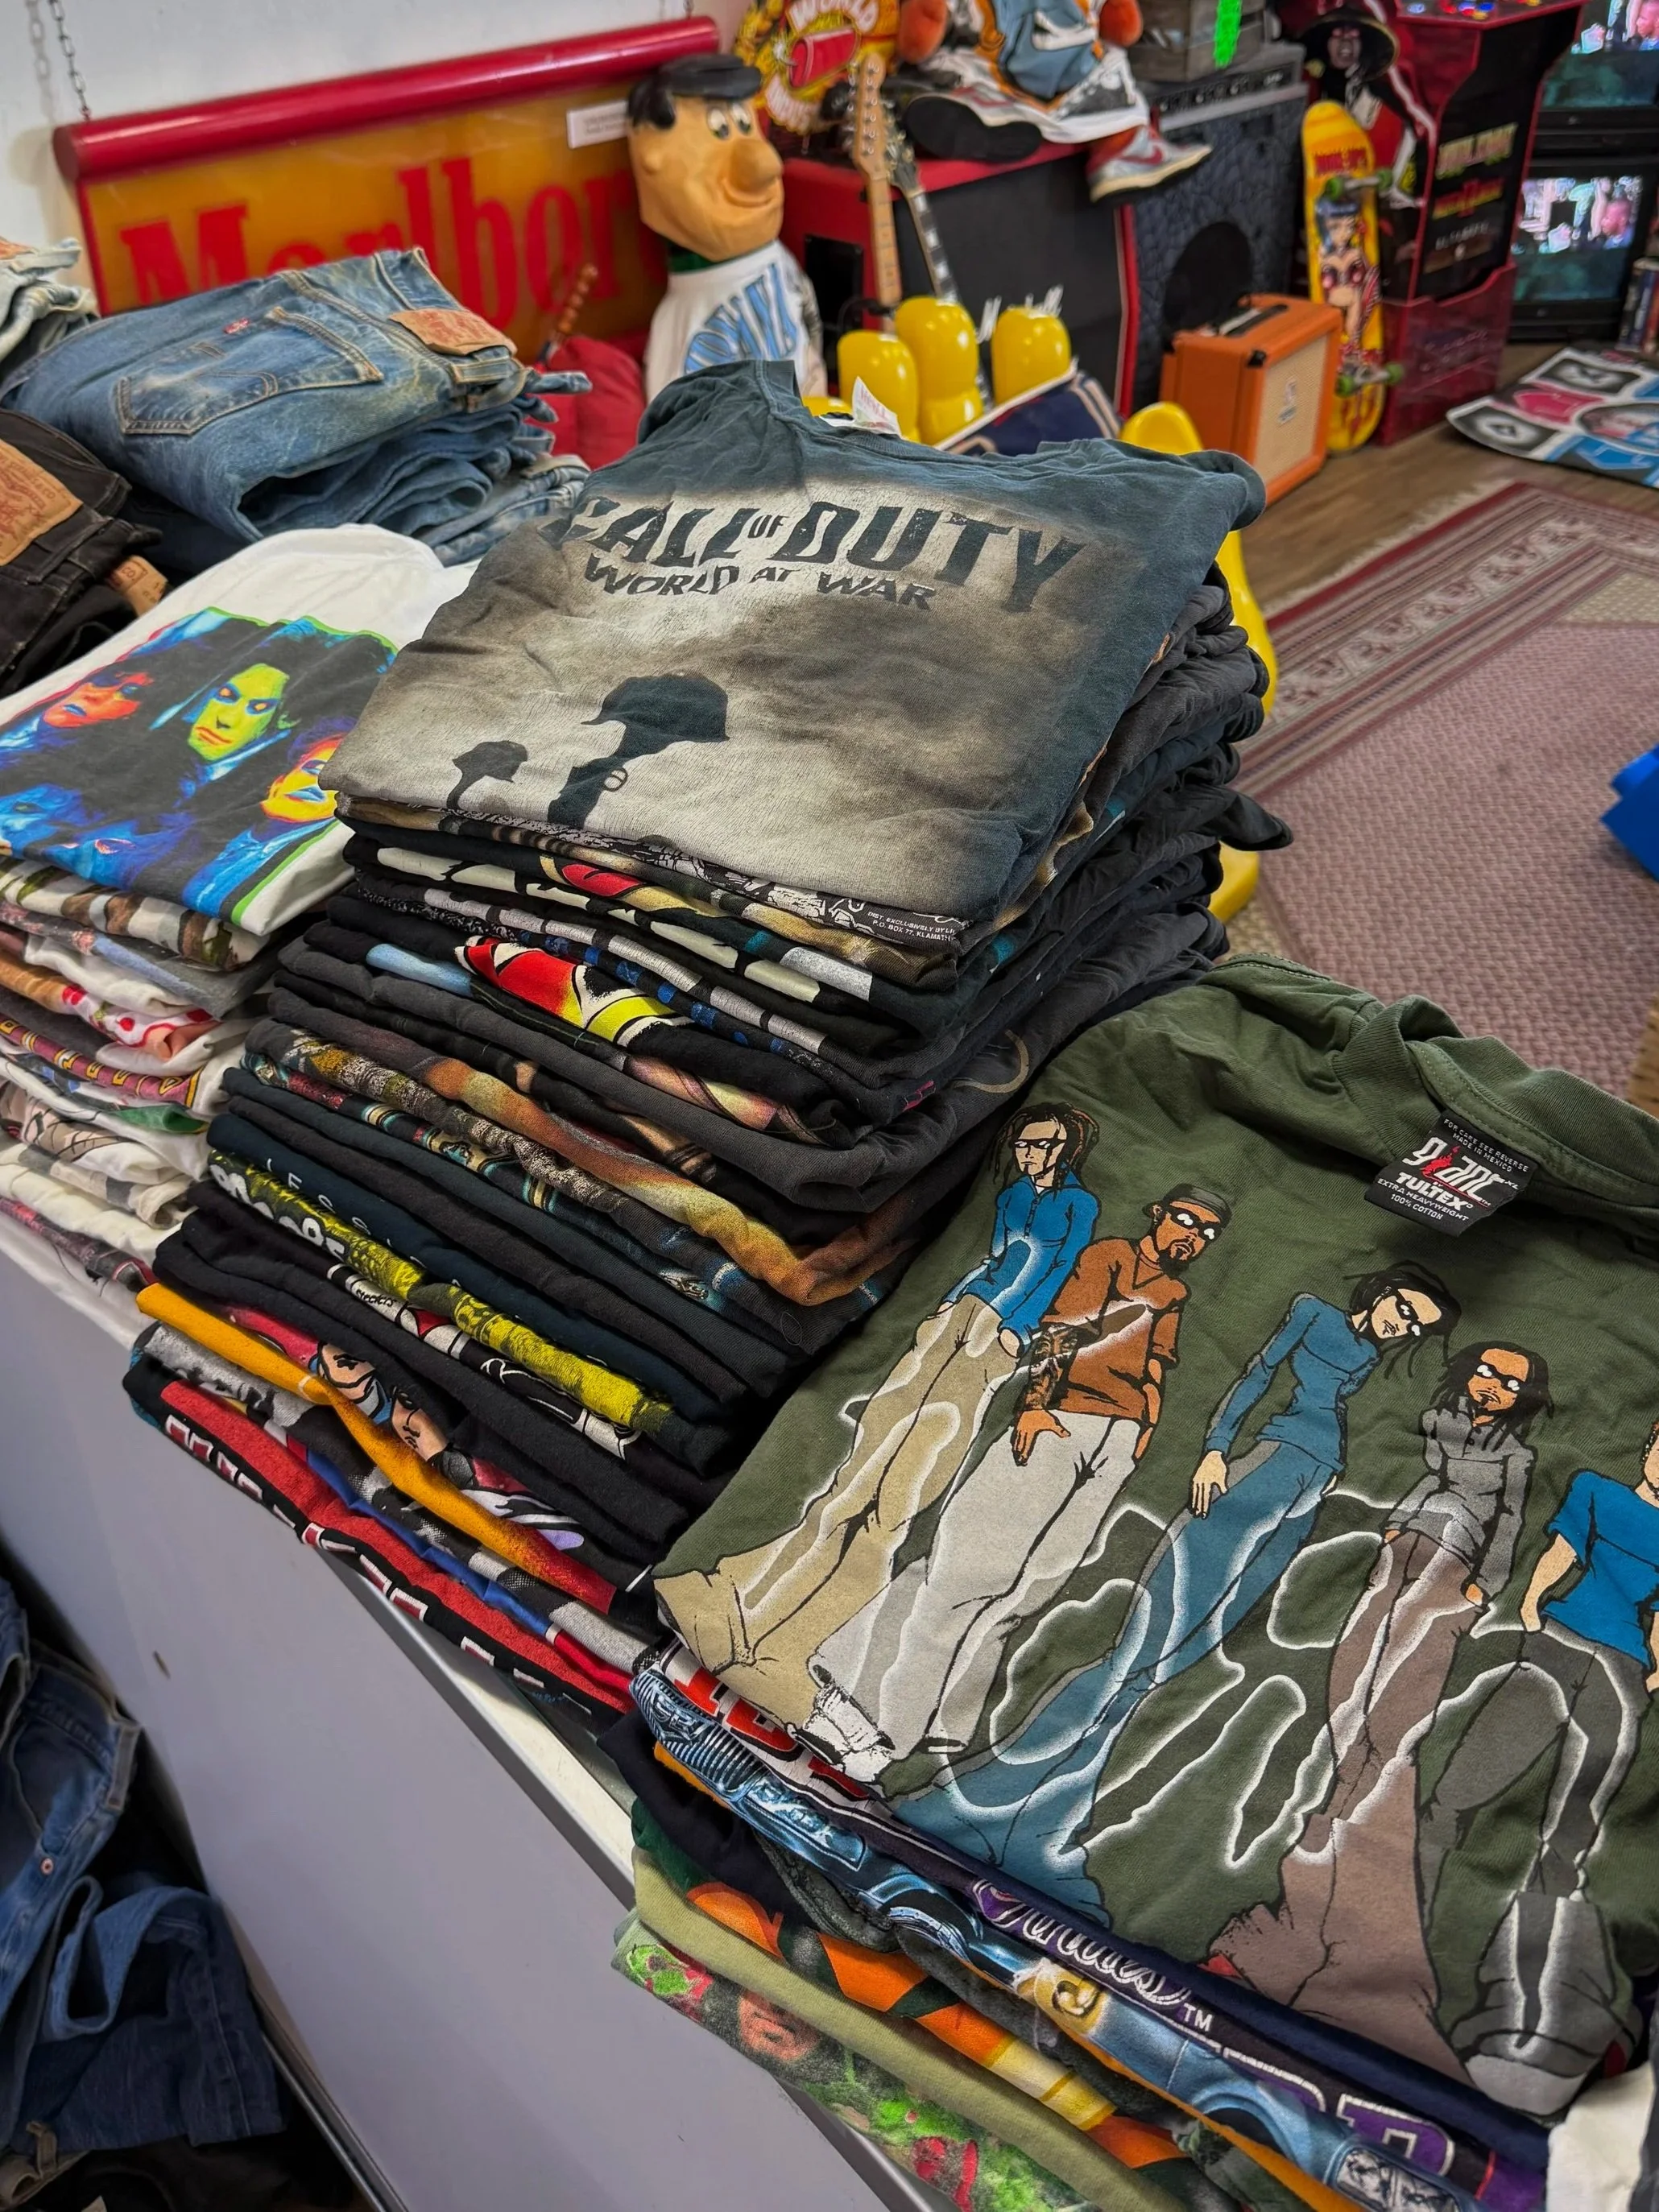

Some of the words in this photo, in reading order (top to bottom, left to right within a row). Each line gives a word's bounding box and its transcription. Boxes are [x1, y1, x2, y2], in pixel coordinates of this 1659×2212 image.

[536, 496, 761, 569] CALL
[747, 514, 792, 539] OF
[767, 501, 1087, 614] DUTY
[583, 552, 740, 596] WORLD
[748, 565, 802, 584] AT
[817, 571, 936, 610] WAR
[867, 911, 884, 921] DIST.
[886, 917, 933, 932] EXCLUSIVELY
[872, 920, 886, 928] P.O.
[887, 924, 904, 933] BOX
[916, 931, 952, 942] KLAMATH
[1443, 1118, 1458, 1133] FOR
[1458, 1129, 1478, 1145] CARE
[1479, 1141, 1494, 1155] SEE
[1494, 1149, 1530, 1172] REVERSE
[1452, 1133, 1473, 1150] MADE
[1474, 1146, 1484, 1156] IN
[1483, 1152, 1512, 1172] MEXICO
[1376, 1177, 1405, 1194] EXTRA
[1405, 1190, 1470, 1221] HEAVYWEIGHT
[1504, 1180, 1520, 1191] XL
[1390, 1193, 1411, 1208] 100%
[1412, 1203, 1444, 1220] COTTON
[1183, 2002, 1214, 2033] TM
